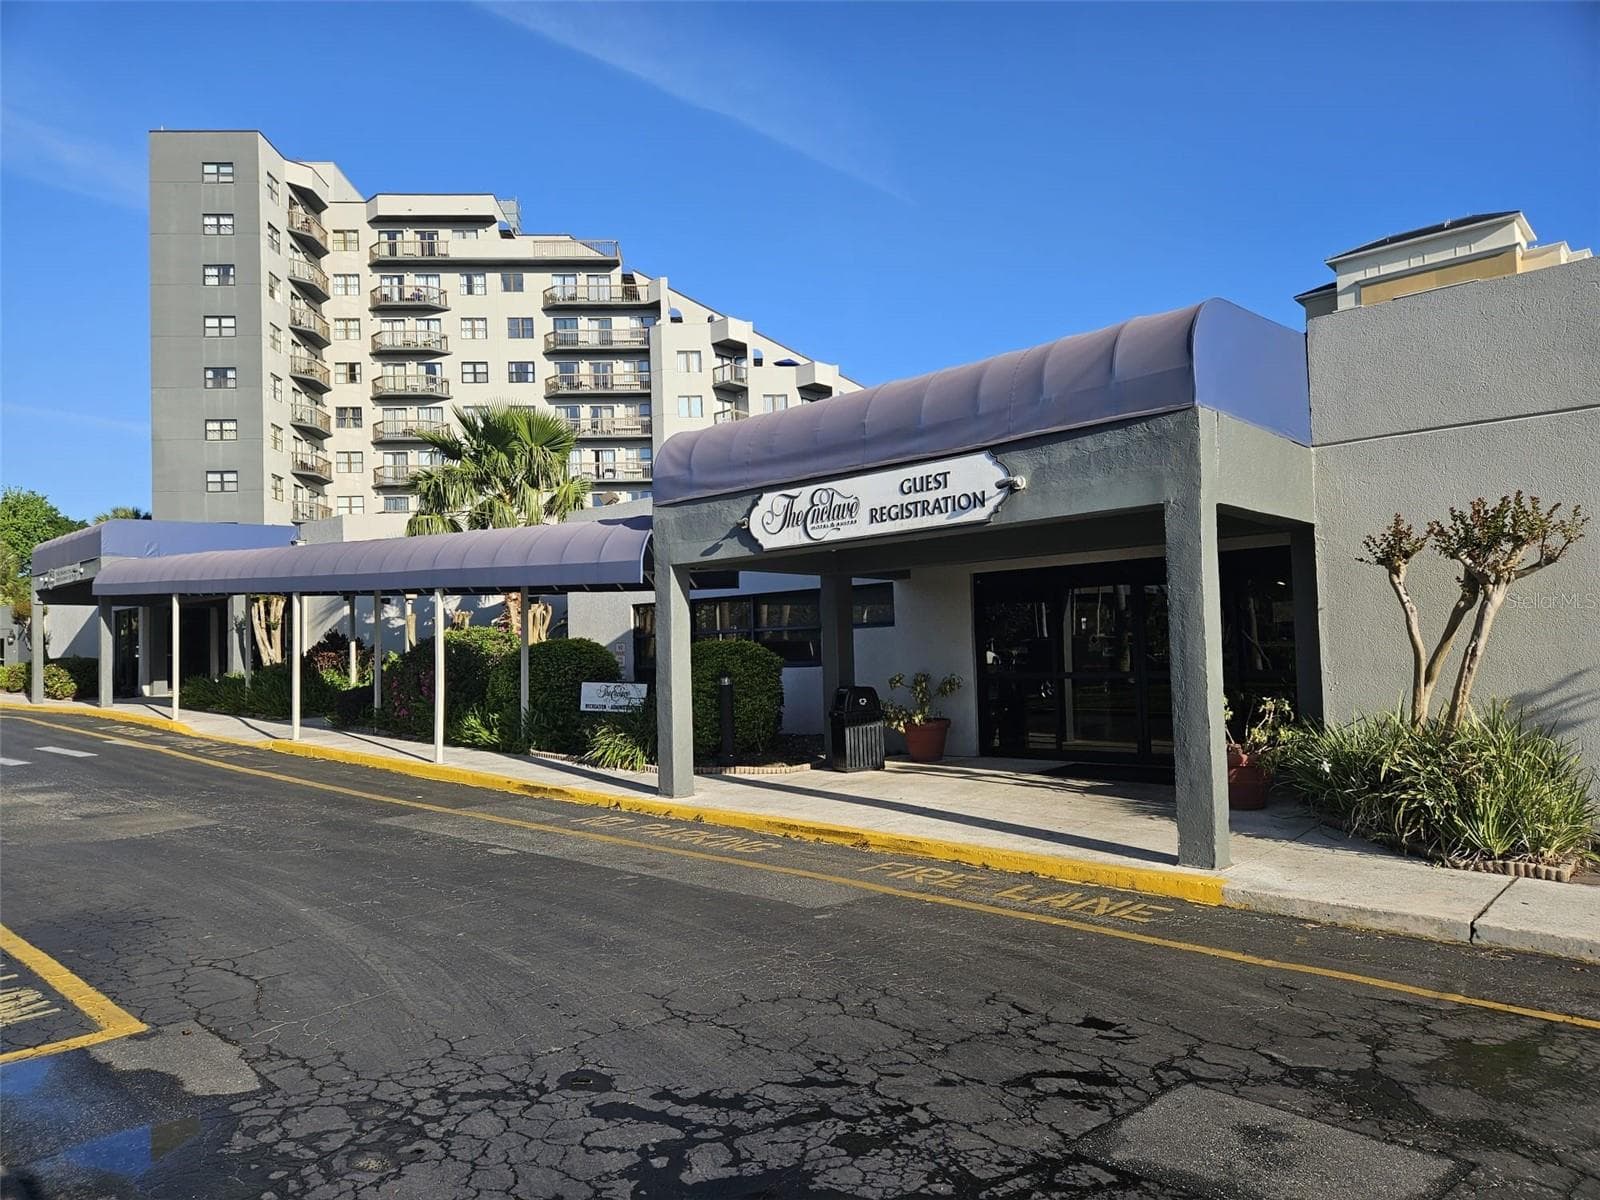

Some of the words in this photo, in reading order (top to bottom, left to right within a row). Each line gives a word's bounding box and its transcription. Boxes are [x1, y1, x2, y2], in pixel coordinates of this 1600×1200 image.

[900, 471, 950, 495] GUEST
[762, 491, 802, 535] The
[803, 488, 860, 541] Enclave
[869, 490, 986, 524] REGISTRATION
[858, 861, 987, 889] FIRE
[995, 885, 1175, 923] LANE
